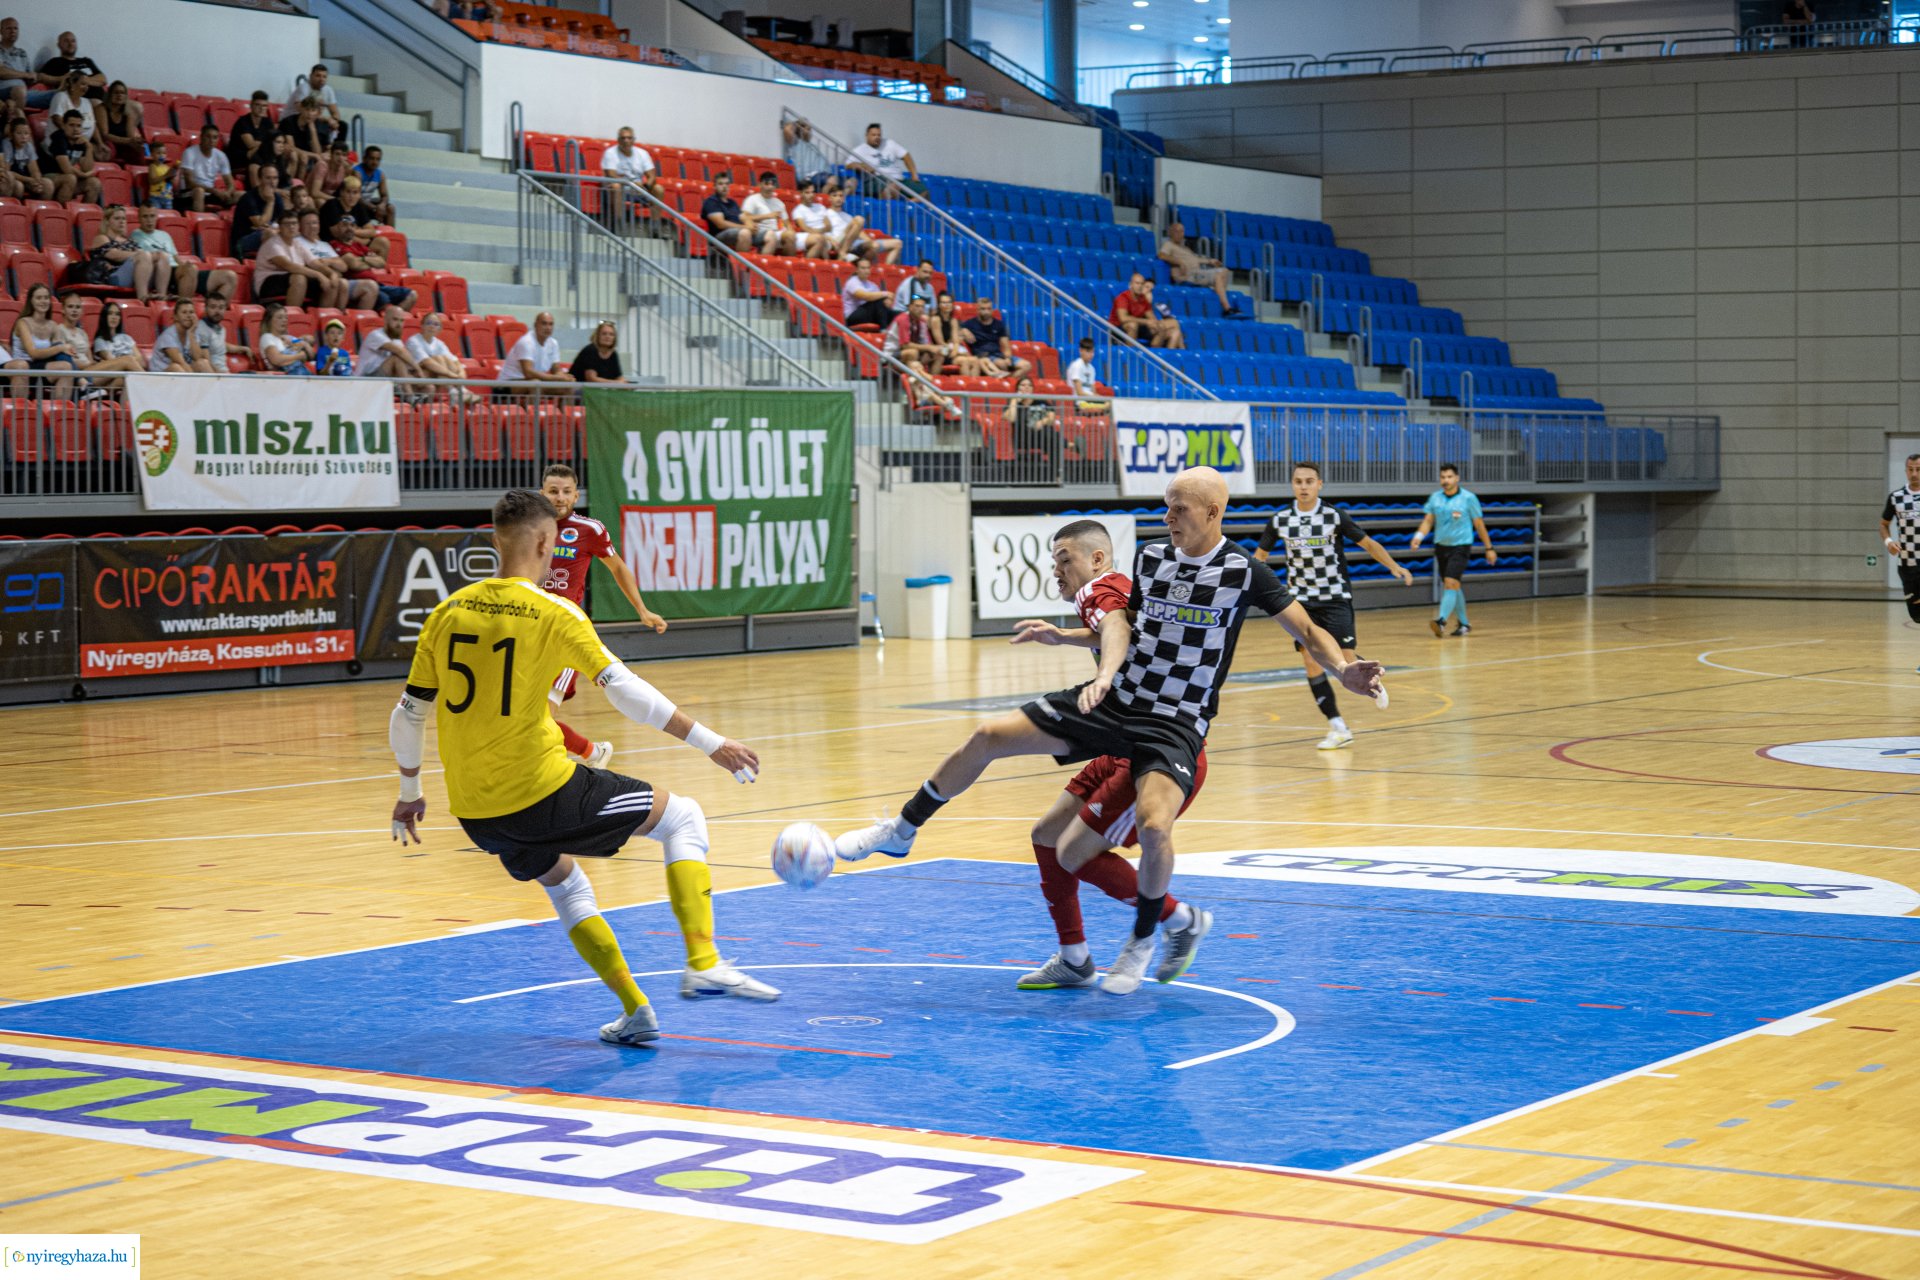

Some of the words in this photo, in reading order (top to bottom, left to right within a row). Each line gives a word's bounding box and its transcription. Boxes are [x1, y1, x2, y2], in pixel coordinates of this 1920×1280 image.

[193, 413, 391, 455] mlsz.hu
[194, 459, 244, 476] Magyar
[249, 458, 319, 476] Labdarúgó
[325, 457, 392, 476] Szövetség
[623, 431, 649, 501] A
[655, 417, 828, 502] GYŰLÖLET
[624, 511, 714, 592] NEM
[720, 510, 830, 589] PÁLYA!
[94, 552, 337, 609] CIPŐRAKTÁR
[161, 608, 337, 633] www.raktarsportbolt.hu
[88, 644, 214, 671] Nyíregyháza,
[217, 641, 293, 660] Kossuth
[296, 642, 313, 655] u.
[445, 632, 516, 716] 51
